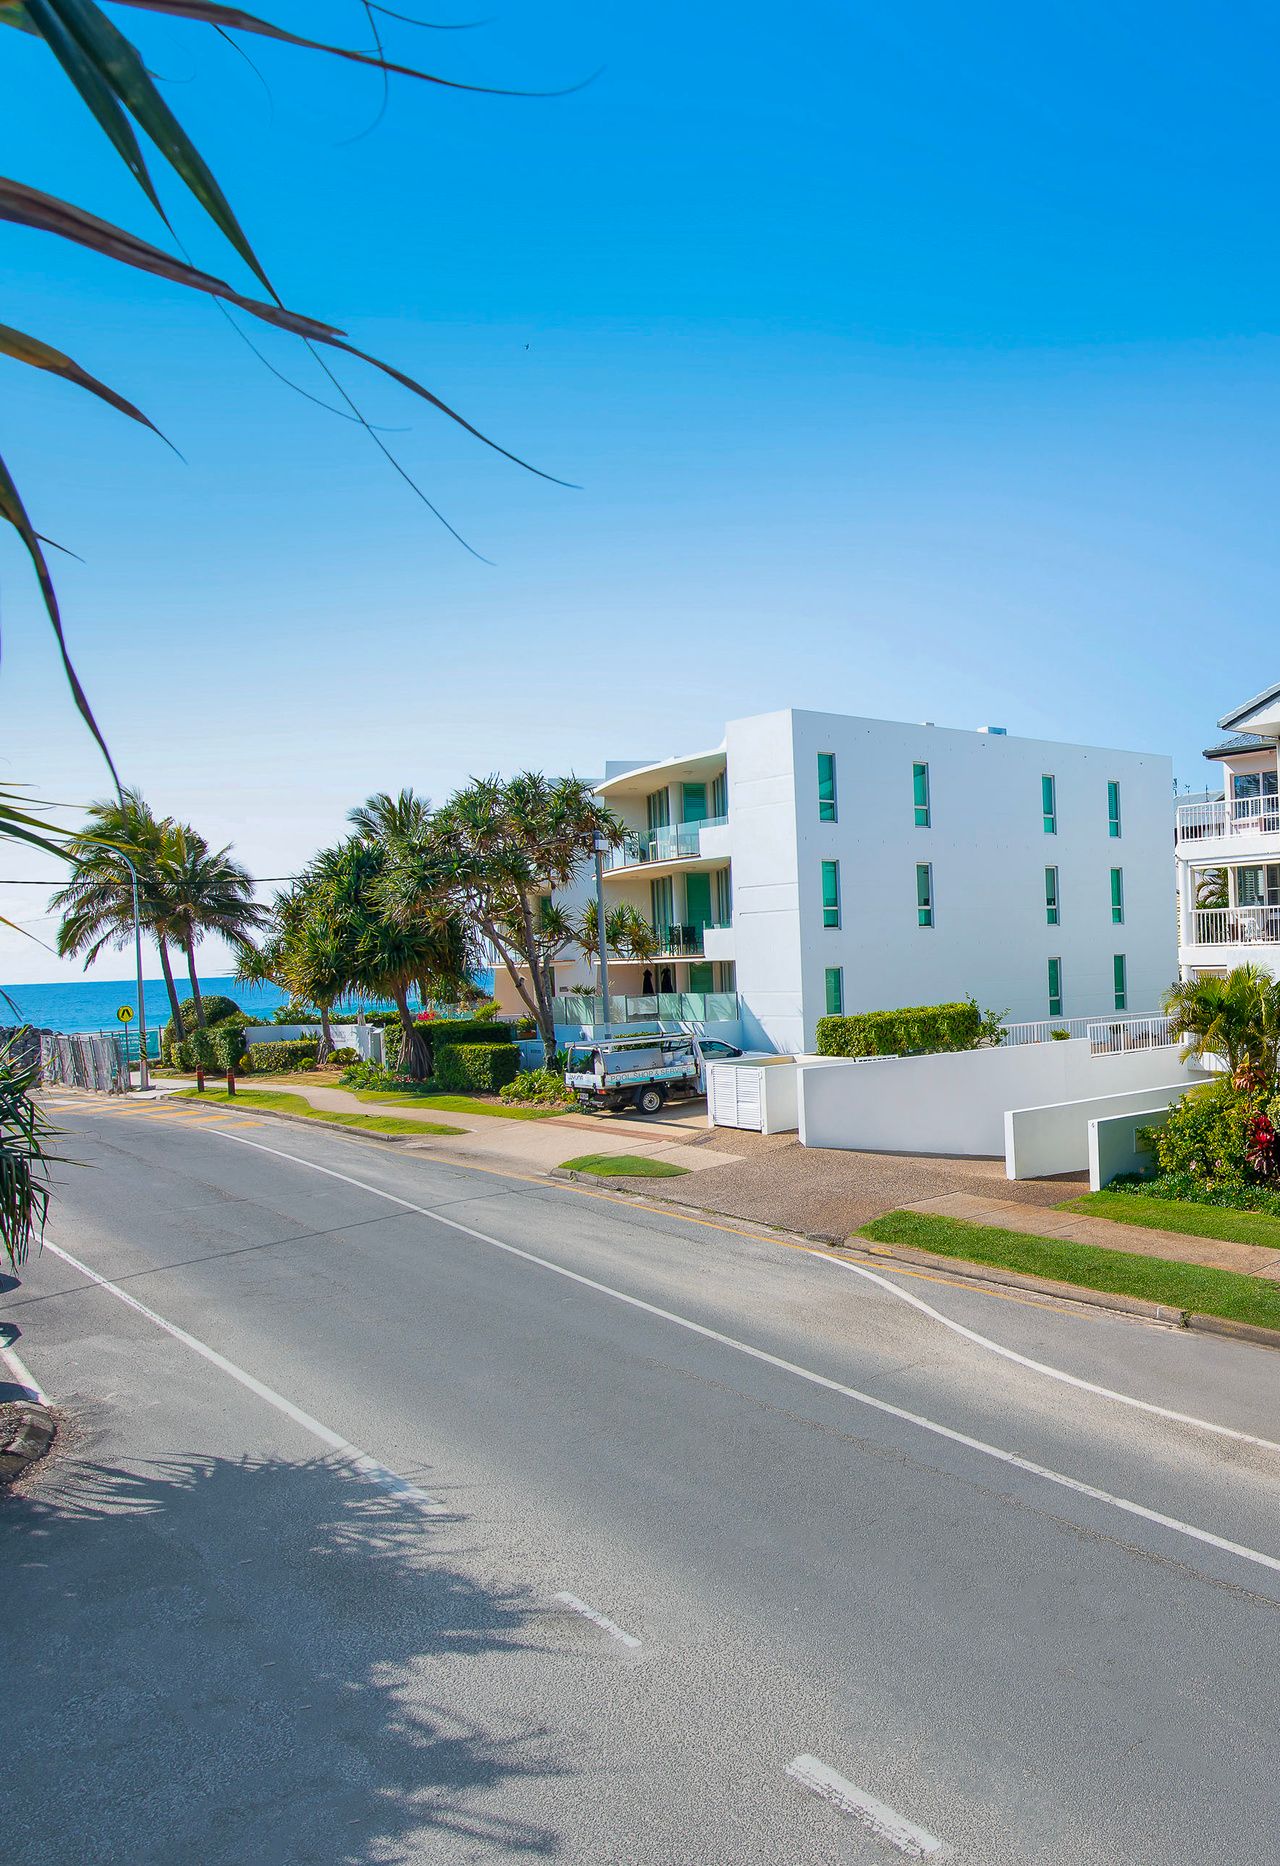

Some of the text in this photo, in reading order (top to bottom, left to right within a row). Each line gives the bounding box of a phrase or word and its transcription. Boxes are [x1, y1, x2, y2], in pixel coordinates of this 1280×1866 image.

[610, 1074, 632, 1082] POOL
[633, 1070, 654, 1079] SHOP
[660, 1066, 692, 1076] SERVICE
